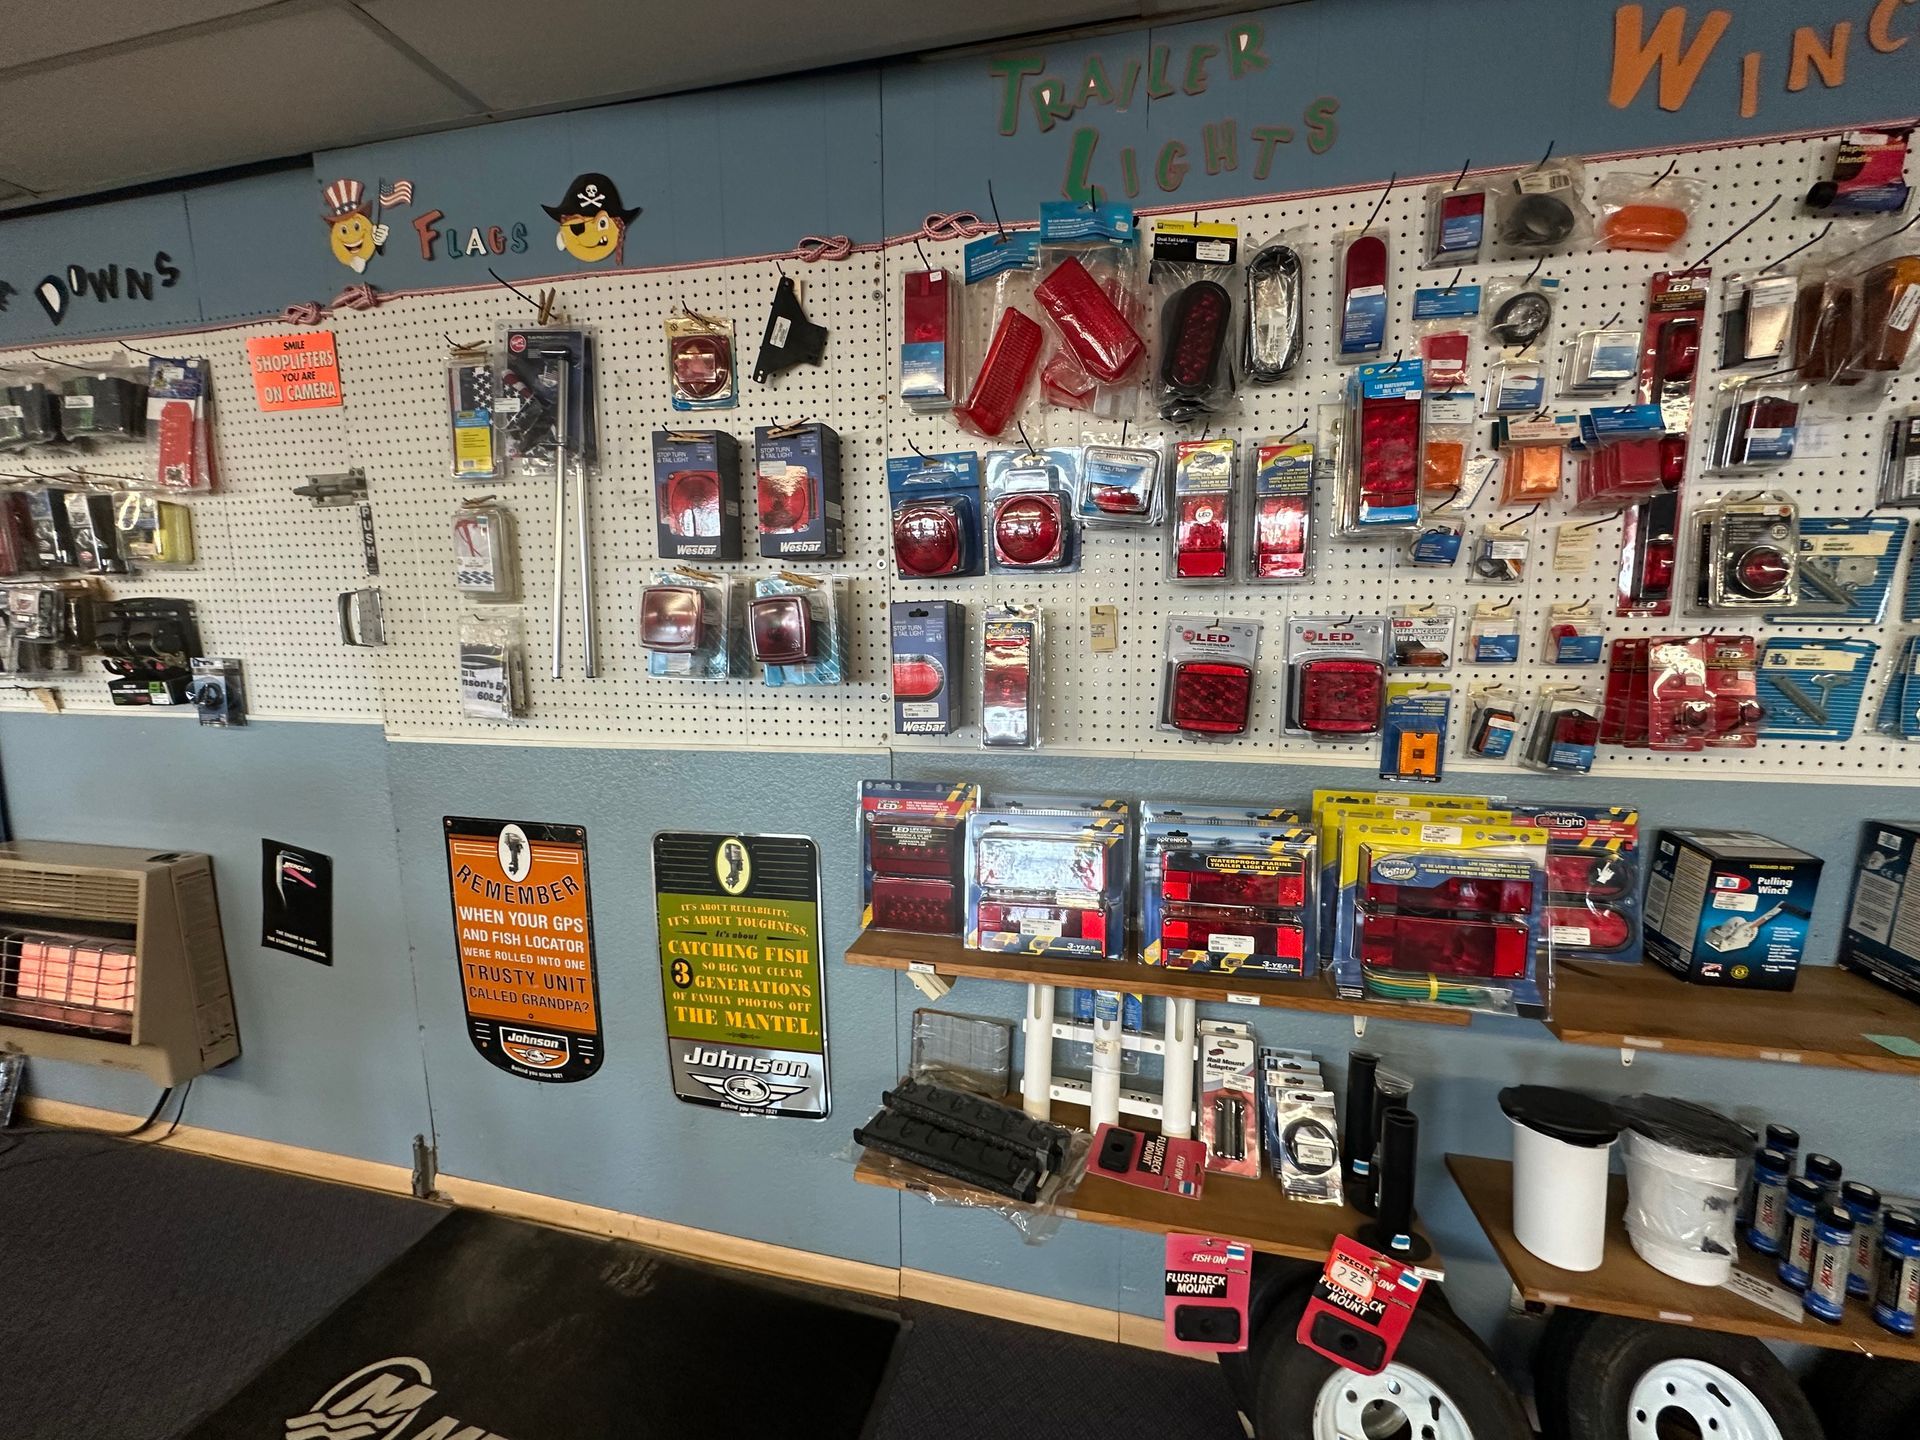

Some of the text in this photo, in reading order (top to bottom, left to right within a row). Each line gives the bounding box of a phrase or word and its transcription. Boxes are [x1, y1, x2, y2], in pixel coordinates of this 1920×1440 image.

[990, 22, 1269, 136] TRAILER
[1062, 97, 1340, 203] LIGHTS
[412, 208, 528, 261] FLAGS
[34, 251, 180, 326] DOWNS
[283, 340, 305, 351] SMILE
[255, 351, 334, 373] SHOPLIFTERS
[282, 371, 316, 382] YOU ARE
[264, 381, 337, 404] ON CAMERA
[361, 507, 376, 557] PUSH
[677, 544, 717, 556] Wesbar
[780, 541, 821, 553] Wesbar
[1196, 634, 1230, 643] LED
[1318, 632, 1354, 641] LED
[903, 721, 946, 732] Wesbar
[1538, 816, 1584, 828] GloLight
[1210, 858, 1260, 866] WATERPROOF
[456, 864, 580, 905] REMEMBER
[1757, 877, 1793, 888] Pulling
[1758, 886, 1788, 895] Winch
[681, 904, 697, 912] IT'S
[699, 903, 728, 912] ABOUT
[459, 906, 584, 934] WHEN YOUR GPS
[667, 915, 809, 937] IT'S ABOUT TOUGHNESS.
[463, 928, 585, 953] AND FISH LOCATOR
[715, 930, 758, 941] It's about
[464, 947, 586, 971] WERE ROLLED INTO ONE
[668, 940, 810, 965] CATCHING FISH
[674, 961, 690, 985] 3
[702, 961, 803, 978] SO BIG YOU CLEAR
[1262, 960, 1295, 969] 3-YEAR
[466, 963, 587, 994] TRUSTY UNIT
[695, 975, 811, 997] GENERATIONS
[469, 985, 590, 1013] CALLED GRANDPA?
[672, 991, 812, 1013] OF FAMILY PHOTOS OFF
[674, 1005, 819, 1036] THE MANTEL.
[507, 1032, 559, 1049] Johnson
[683, 1047, 809, 1077] Johnson
[1206, 1063, 1237, 1071] Adapter
[1222, 1058, 1245, 1067] Mount
[720, 1102, 738, 1111] Behind
[1142, 1140, 1156, 1166] MOUNT
[1150, 1135, 1167, 1175] FLUSH DECK
[1191, 1253, 1228, 1265] FISH-ON!
[1166, 1273, 1226, 1286] FLUSH DECK
[1819, 1252, 1834, 1290] AMSOIL
[1176, 1283, 1216, 1294] MOUNT
[1327, 1291, 1370, 1316] MOUNT
